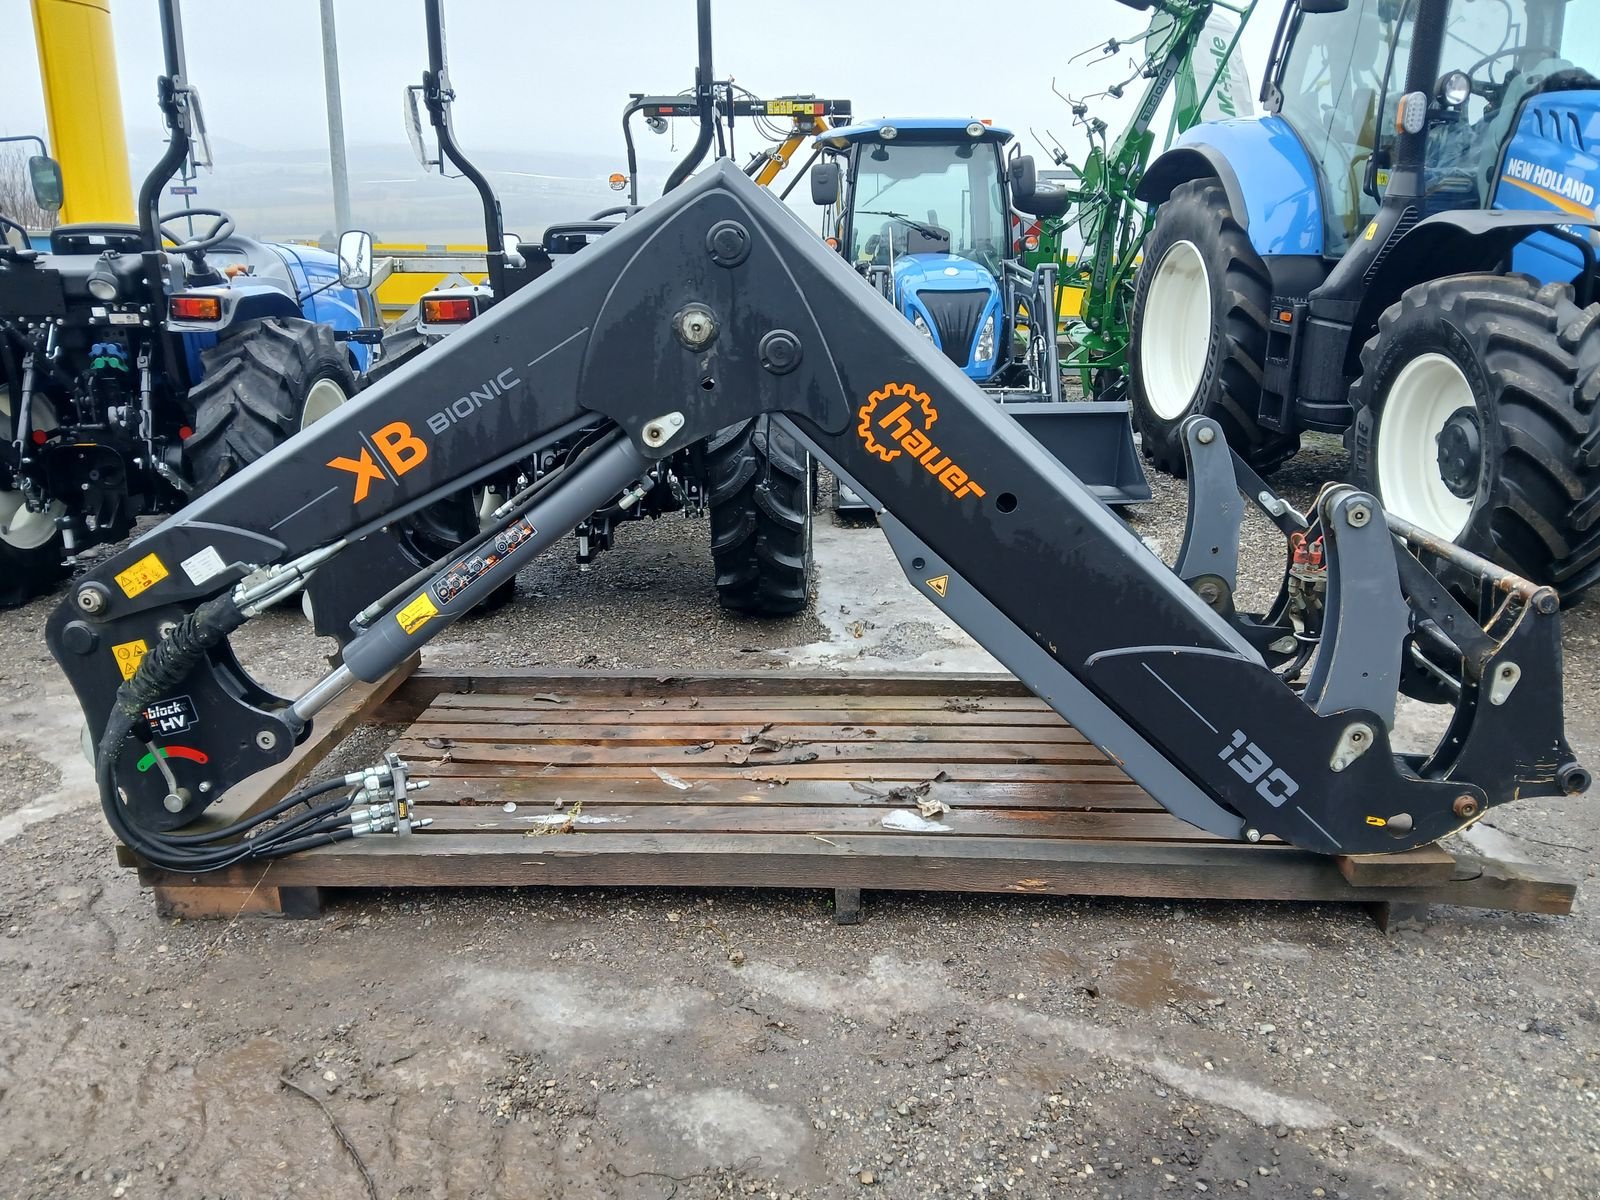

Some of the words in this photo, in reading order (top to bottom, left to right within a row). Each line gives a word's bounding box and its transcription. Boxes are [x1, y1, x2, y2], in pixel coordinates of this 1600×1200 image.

[1140, 68, 1172, 122] PROPEL
[1507, 158, 1535, 181] NEW
[1532, 164, 1595, 206] HOLLAND
[425, 367, 522, 435] BIONIC
[878, 401, 986, 499] hauer
[160, 714, 185, 731] HV
[1218, 728, 1300, 808] 130
